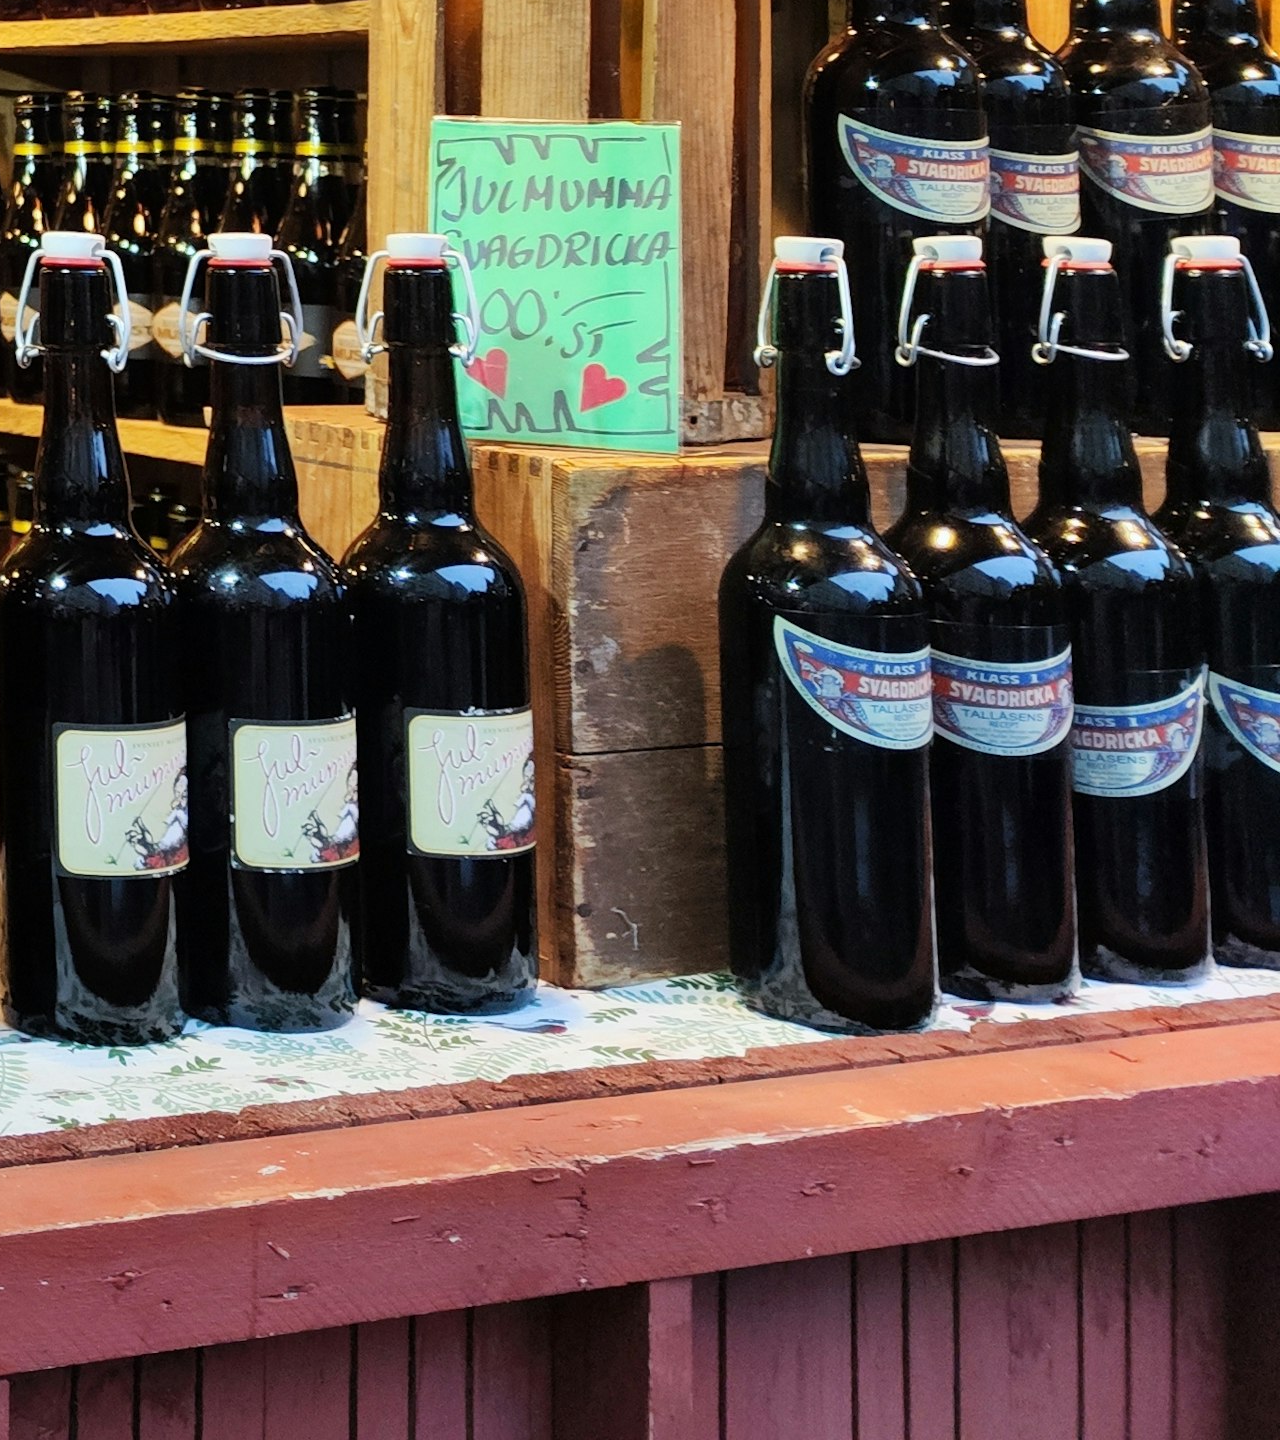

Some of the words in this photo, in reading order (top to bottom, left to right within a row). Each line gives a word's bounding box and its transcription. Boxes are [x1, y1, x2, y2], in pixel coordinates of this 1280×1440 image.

[922, 149, 966, 160] KLASS
[1152, 143, 1193, 154] KLASS
[1028, 163, 1065, 174] KLASS
[440, 165, 672, 222] JULMUMMA
[442, 228, 678, 271] SVAGDRICKA
[874, 663, 916, 675] KLASS
[966, 671, 1021, 685] KLASS
[950, 680, 1055, 707] SVAGDRICKA
[1074, 717, 1117, 727] LASS
[1073, 728, 1162, 750] AGDRICKA
